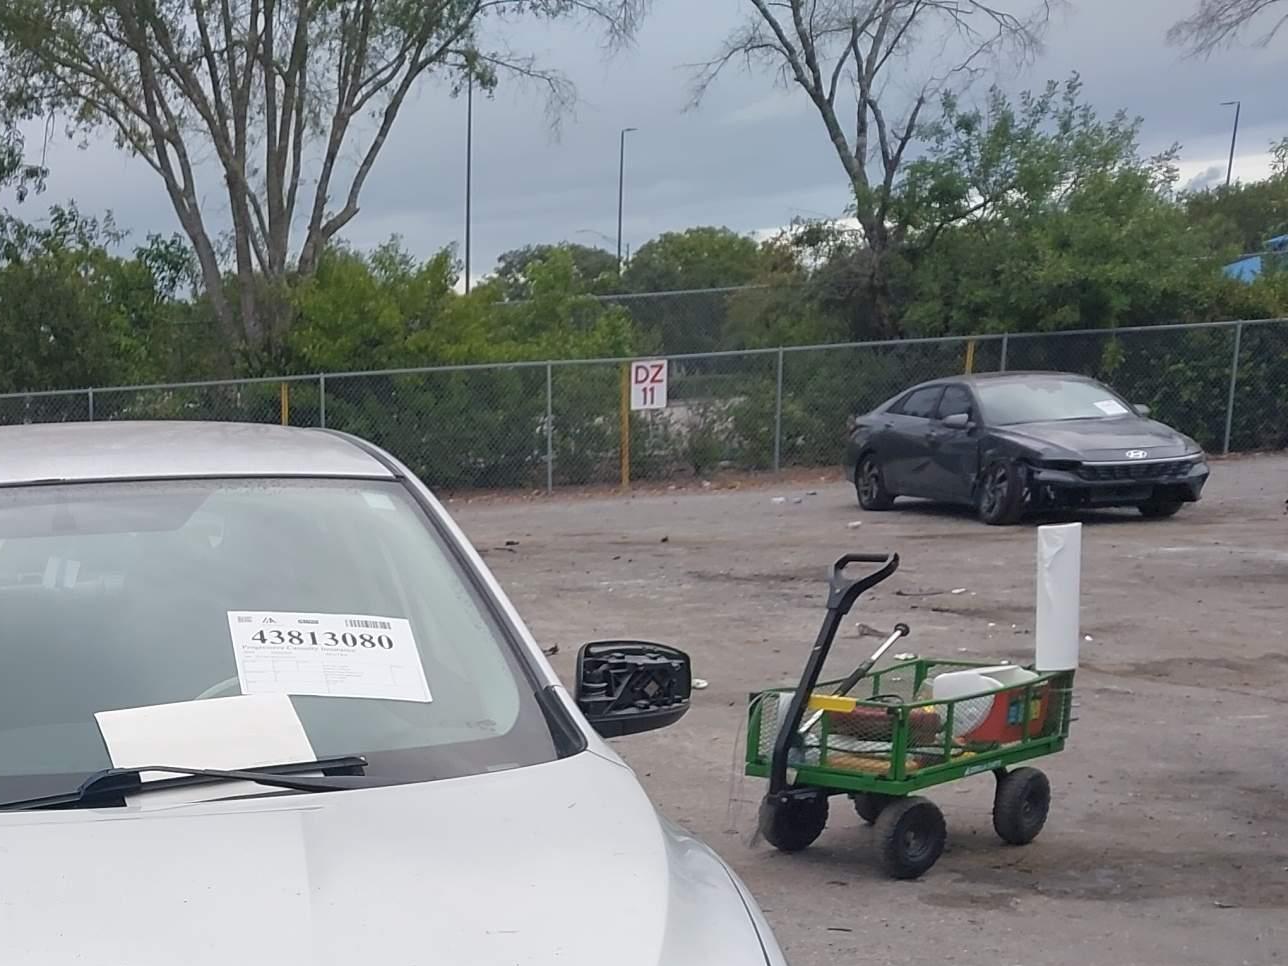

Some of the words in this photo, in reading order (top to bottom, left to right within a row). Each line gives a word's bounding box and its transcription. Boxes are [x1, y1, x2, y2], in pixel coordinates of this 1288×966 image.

[635, 364, 664, 384] DZ
[641, 386, 655, 405] 11
[251, 629, 394, 650] 43813080
